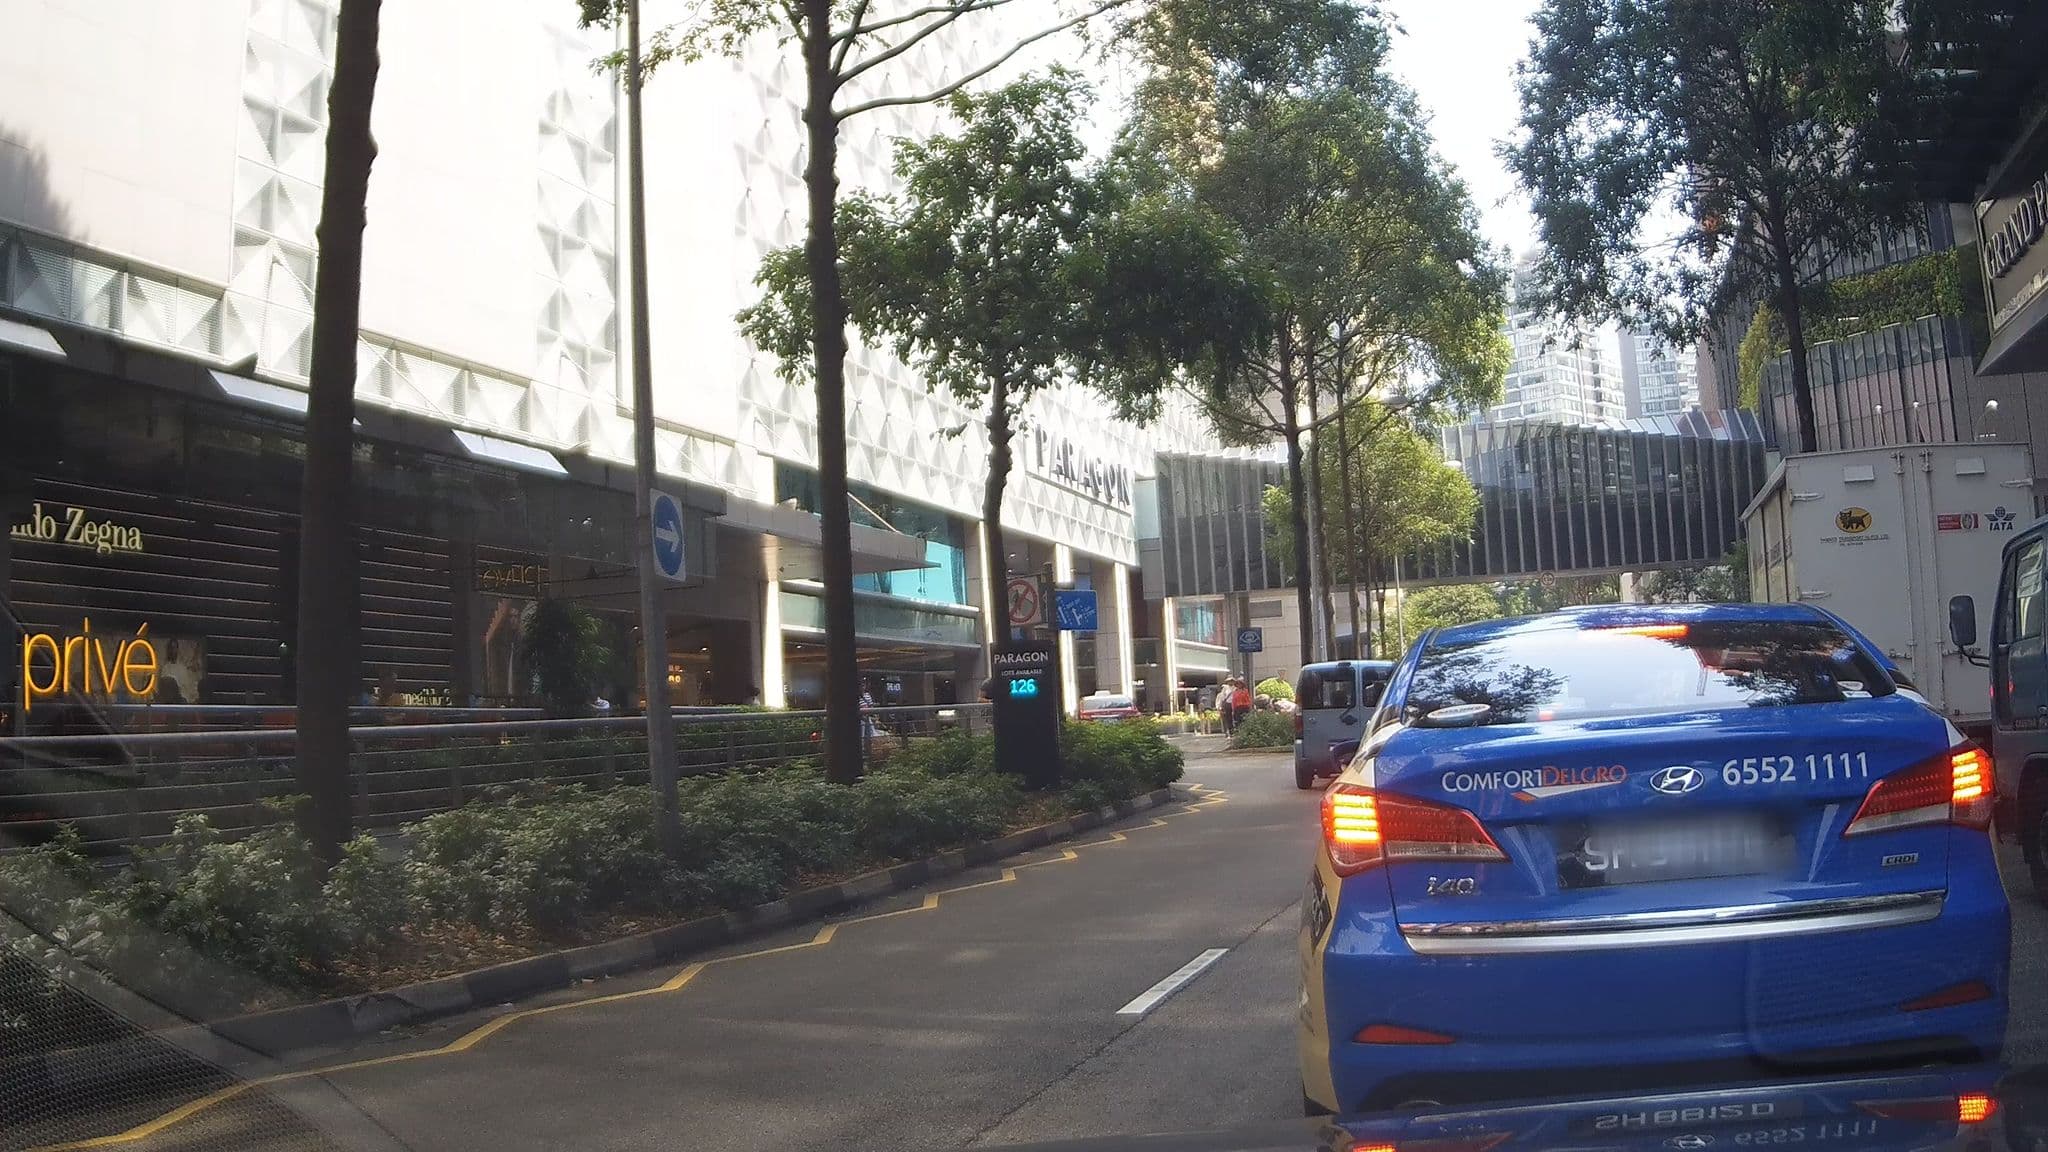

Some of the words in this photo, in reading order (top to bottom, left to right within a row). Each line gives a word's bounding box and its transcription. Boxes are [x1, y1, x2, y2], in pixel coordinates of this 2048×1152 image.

[1984, 198, 2033, 280] GRAND
[1034, 424, 1131, 506] PARAGON
[64, 507, 143, 554] Zegna
[1989, 521, 2013, 532] IATA
[24, 616, 157, 711] privé
[993, 651, 1049, 665] PARAGON
[1009, 678, 1036, 694] 126
[1722, 755, 1797, 786] 6552
[1805, 751, 1868, 781] 1111
